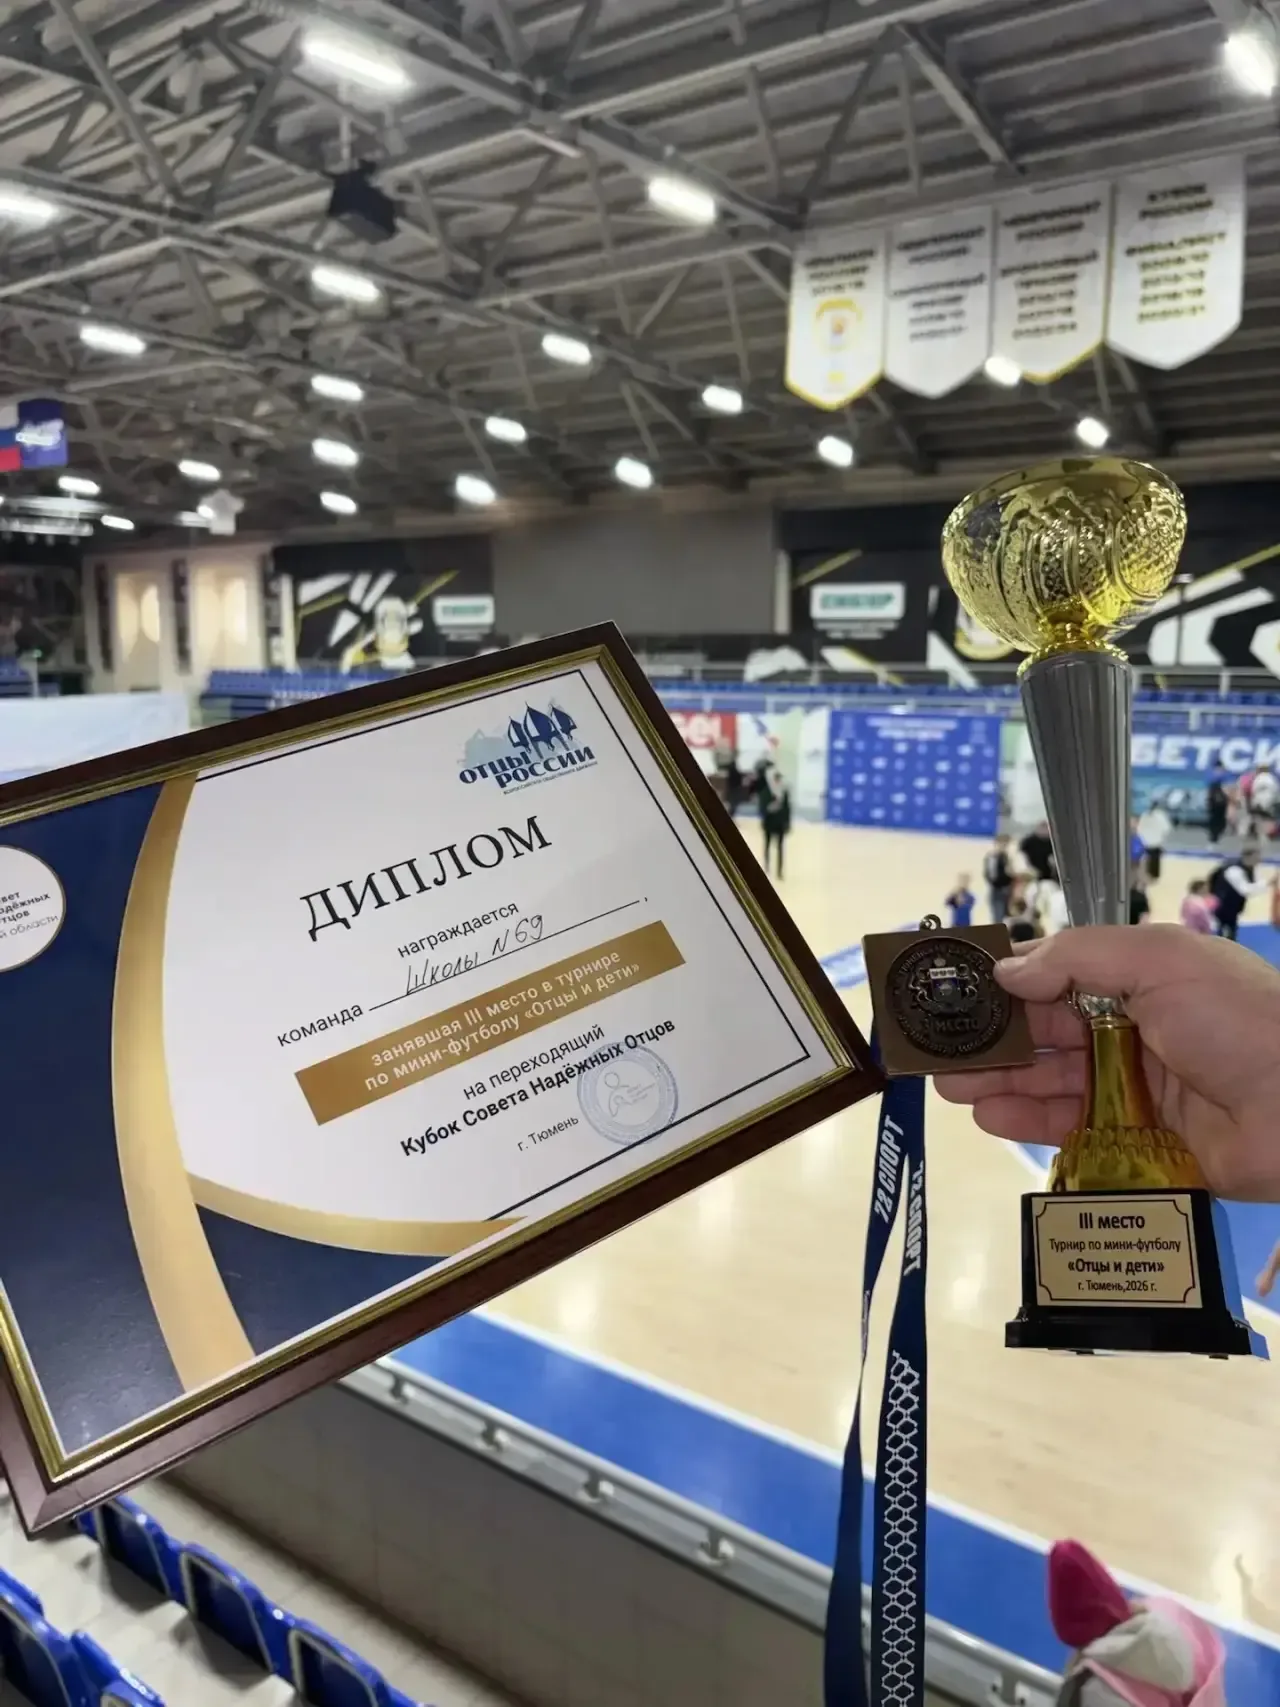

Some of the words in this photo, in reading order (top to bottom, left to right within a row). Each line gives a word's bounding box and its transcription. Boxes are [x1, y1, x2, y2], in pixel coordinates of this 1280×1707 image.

[459, 751, 532, 784] ОТЦЫ
[495, 746, 596, 788] РОССИИ
[300, 815, 552, 941] ДИПЛОМ
[10, 915, 59, 936] области
[398, 902, 519, 958] награждается
[406, 952, 479, 995] Школы
[277, 1004, 363, 1047] команда
[364, 1071, 389, 1091] по
[393, 1013, 520, 1080] мини-футболу
[525, 989, 577, 1020] «Отцы
[581, 984, 592, 996] и
[596, 962, 640, 993] дети»
[371, 1019, 462, 1067] занявшая
[465, 1008, 482, 1027] III
[488, 988, 538, 1015] место
[542, 978, 552, 992] в
[556, 950, 621, 988] турнире
[464, 1082, 485, 1100] на
[490, 1024, 605, 1087] переходящий
[400, 1118, 461, 1156] Кубок
[462, 1087, 529, 1128] Совета
[530, 1043, 623, 1100] Надёжных
[624, 1020, 676, 1050] Отцов
[517, 1140, 528, 1152] г.
[528, 1117, 579, 1144] Тюмень
[878, 1114, 904, 1194] СПОРТ
[874, 1188, 893, 1224] 72
[1079, 1212, 1094, 1229] III
[1098, 1214, 1146, 1229] место
[903, 1194, 923, 1276] СПОРТ
[1048, 1238, 1086, 1252] Турнир
[1088, 1241, 1101, 1250] по
[1103, 1237, 1181, 1253] мини-футболу
[1067, 1258, 1110, 1274] «Отцы
[1113, 1260, 1123, 1272] и
[1125, 1260, 1165, 1275] дети»
[1077, 1282, 1085, 1291] г.
[1150, 1282, 1158, 1291] г.
